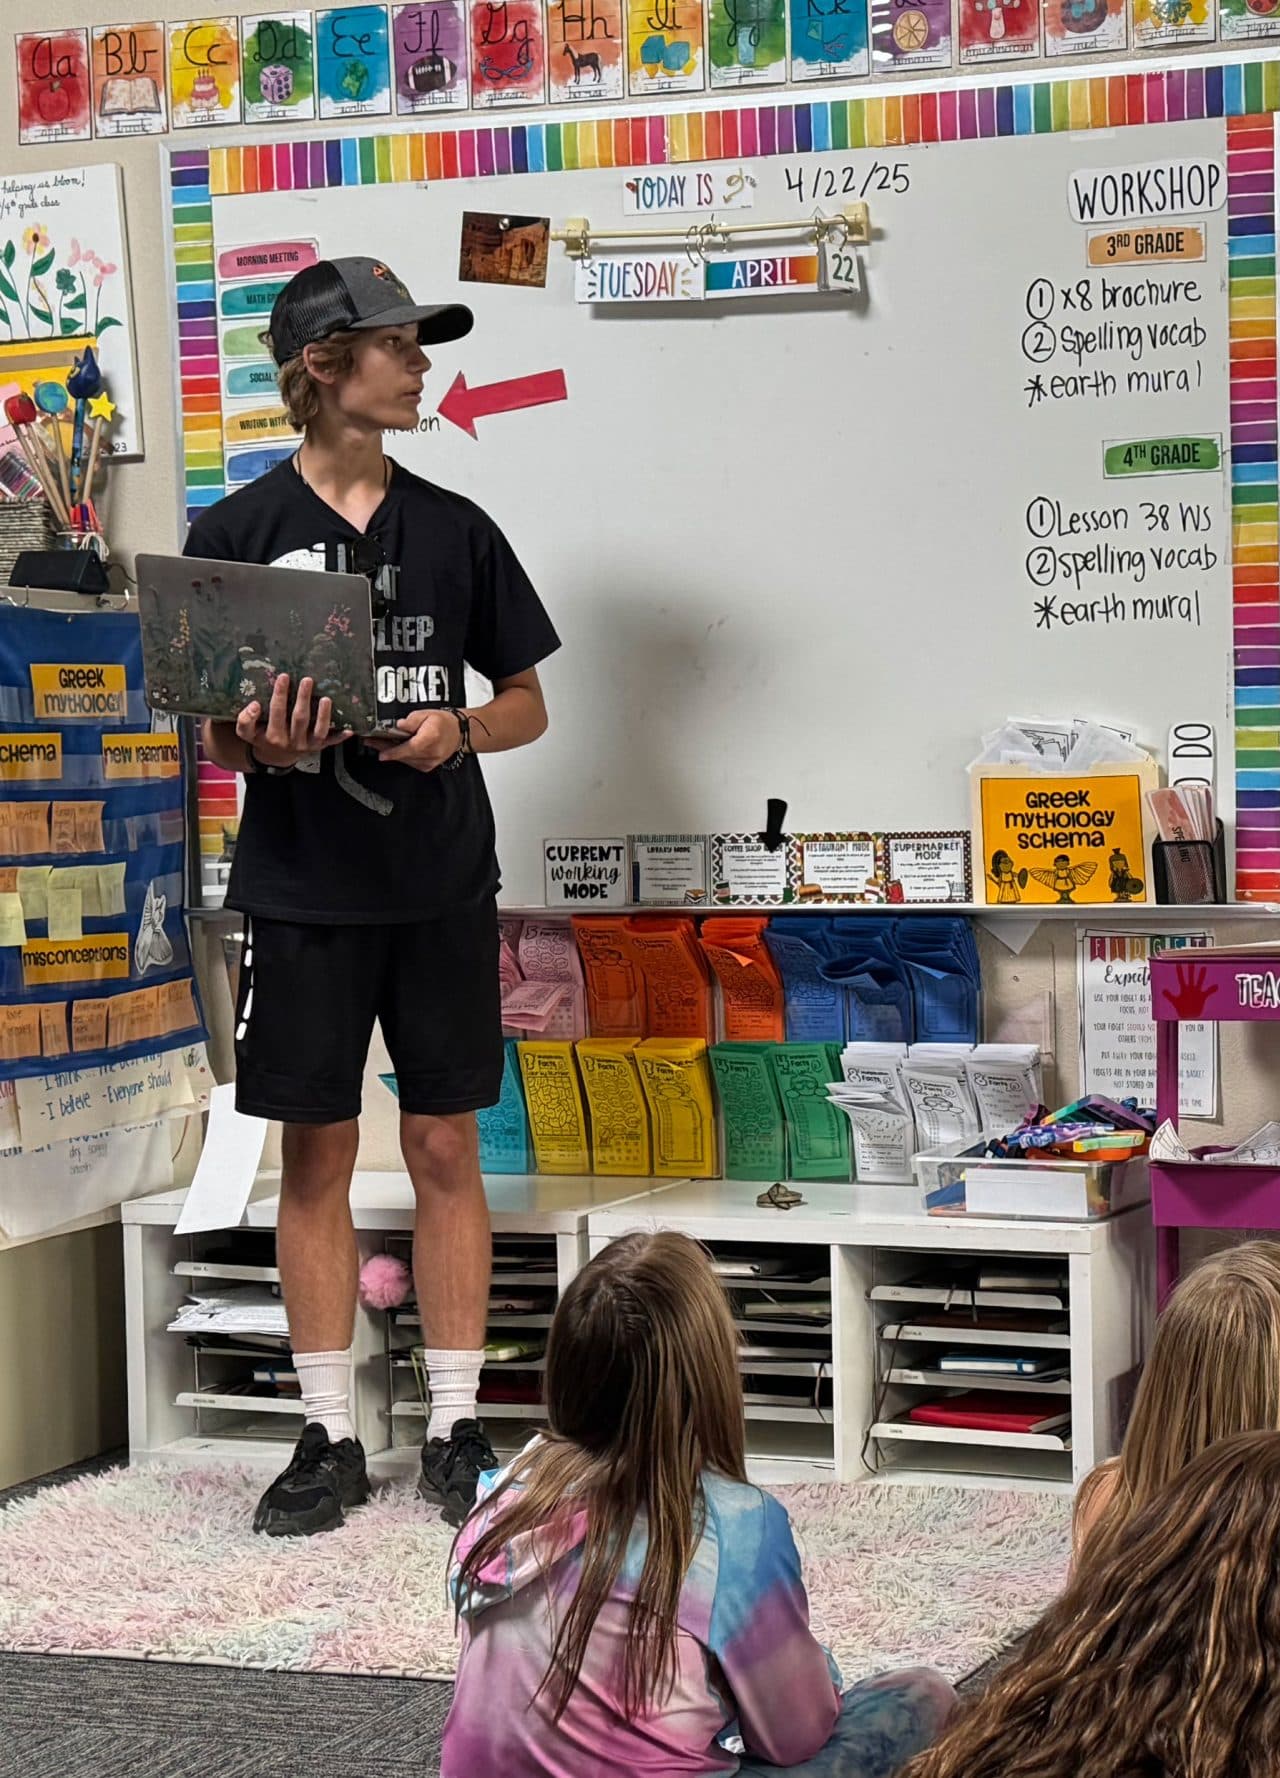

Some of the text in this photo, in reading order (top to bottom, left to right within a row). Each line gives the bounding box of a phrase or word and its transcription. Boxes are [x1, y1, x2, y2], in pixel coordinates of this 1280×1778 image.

[633, 172, 713, 209] TODAY IS
[786, 162, 910, 202] 4/22/25
[1073, 164, 1221, 219] WORKSHOP
[1135, 231, 1185, 255] GRADE
[237, 251, 299, 267] MORNING MEETING
[730, 257, 798, 289] APRIL
[831, 253, 855, 283] 22
[596, 260, 679, 299] TUESDAY
[1101, 278, 1202, 311] brochure
[247, 293, 265, 305] MATH
[249, 372, 273, 383] SOCIAL
[1128, 360, 1201, 393] mural
[239, 418, 268, 430] WRITING
[1150, 443, 1200, 466] GRADE
[1056, 500, 1128, 536] Lesson
[1139, 502, 1169, 531] 38
[1133, 590, 1200, 626] mural
[374, 615, 434, 652] LEEP
[376, 665, 449, 703] OCKEY
[546, 845, 625, 862] CURRENT
[894, 842, 960, 852] SUPERMARKET
[915, 851, 941, 860] MODE
[563, 883, 609, 899] MODE
